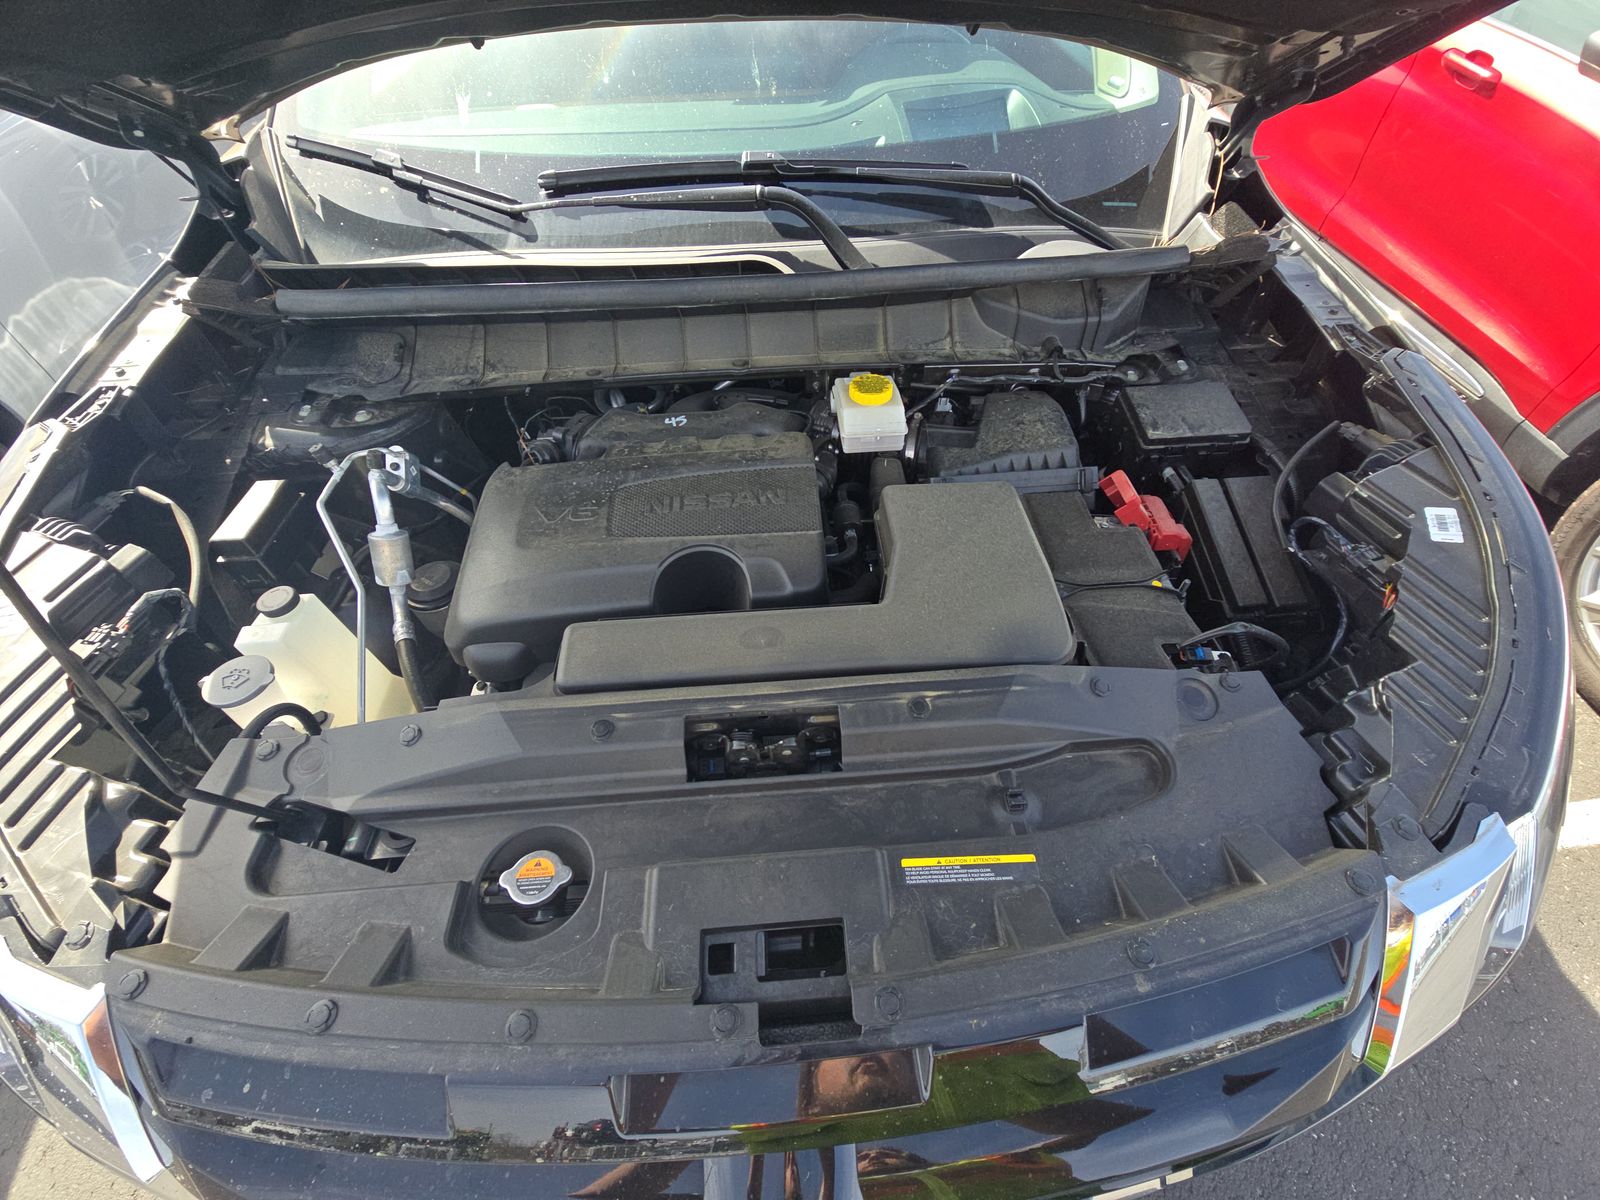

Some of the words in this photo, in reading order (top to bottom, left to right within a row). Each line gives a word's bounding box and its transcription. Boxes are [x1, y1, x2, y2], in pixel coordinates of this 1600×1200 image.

[664, 415, 687, 427] 45
[648, 489, 787, 514] NISSAN
[535, 506, 600, 524] V6
